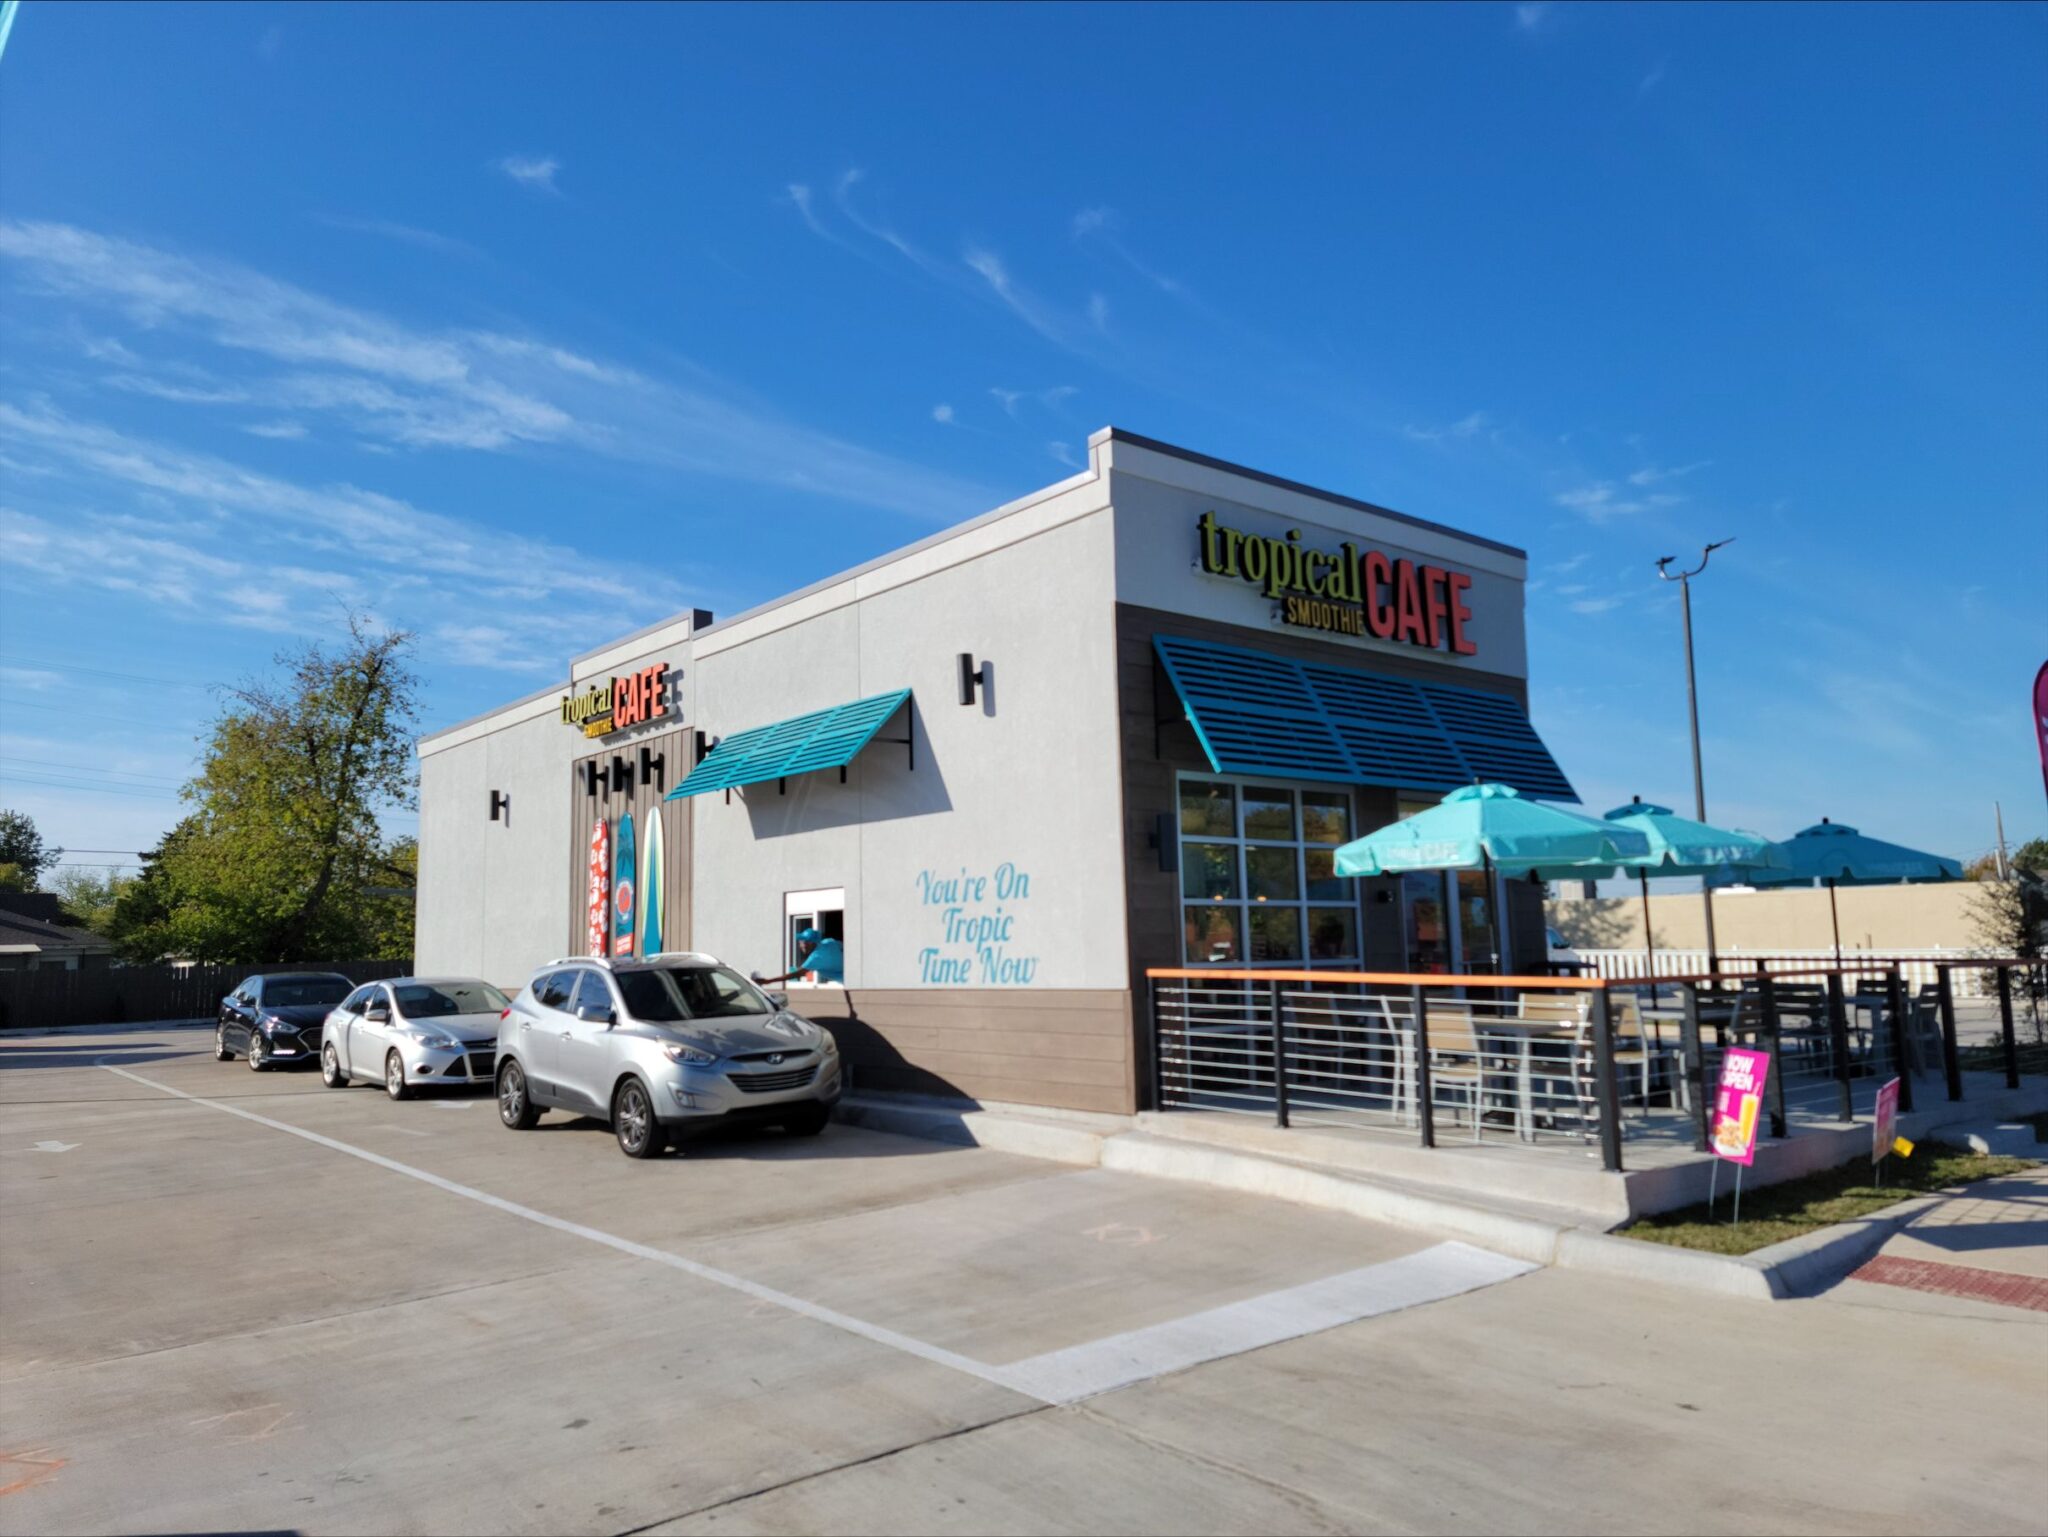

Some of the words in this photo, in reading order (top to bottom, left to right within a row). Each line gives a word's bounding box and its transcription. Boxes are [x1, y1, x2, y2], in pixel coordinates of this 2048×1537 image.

[1199, 511, 1364, 603] tropical
[1286, 596, 1365, 636] SMOOTHIE
[1364, 550, 1477, 656] CAFE
[561, 677, 614, 726] tropical
[613, 663, 669, 729] CAFE
[916, 867, 987, 905] You're
[995, 862, 1029, 900] On
[942, 906, 1014, 954] Tropic
[919, 947, 972, 984] Time
[980, 946, 1038, 984] Now
[1720, 1070, 1755, 1091] OPEN
[1723, 1053, 1755, 1074] NOW
